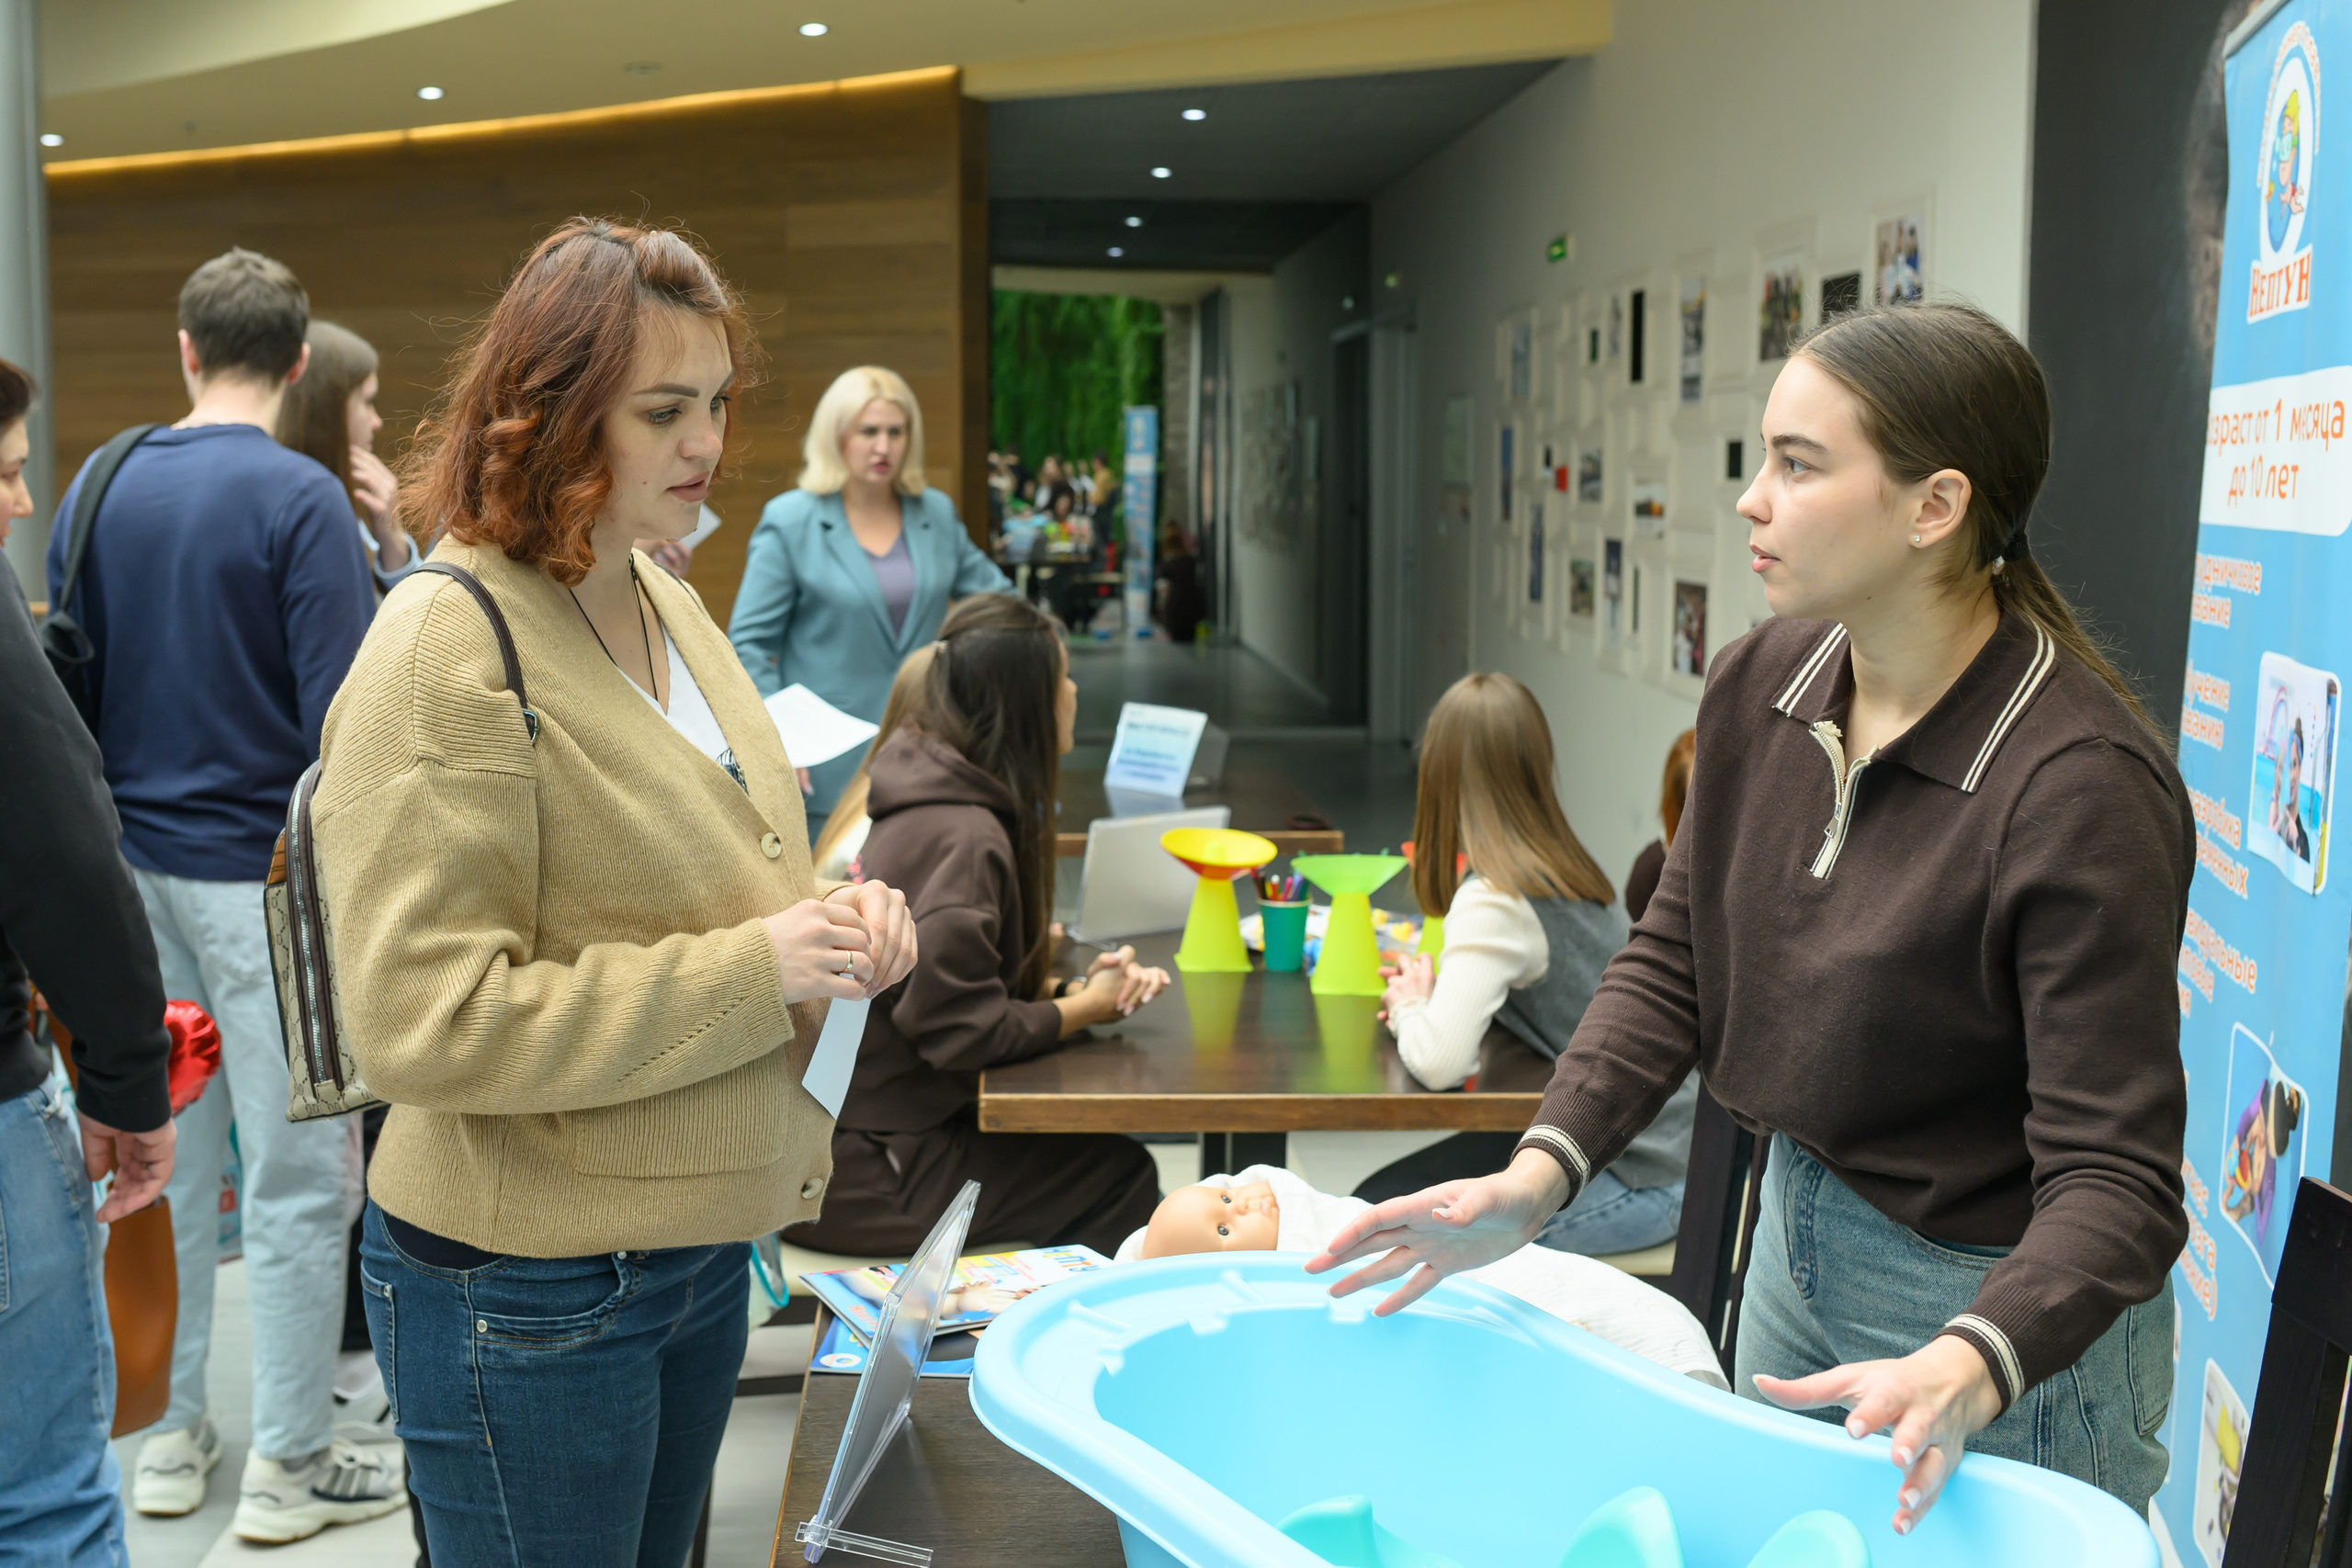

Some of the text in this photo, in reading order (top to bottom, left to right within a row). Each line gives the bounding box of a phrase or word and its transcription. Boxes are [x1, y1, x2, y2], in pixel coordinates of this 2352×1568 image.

[2248, 251, 2312, 318] НЕПТУН
[2207, 398, 2346, 457] зраст от 1 месяца
[2227, 454, 2300, 506] до 10 лет
[1040, 1247, 1100, 1272] НЕПТУ
